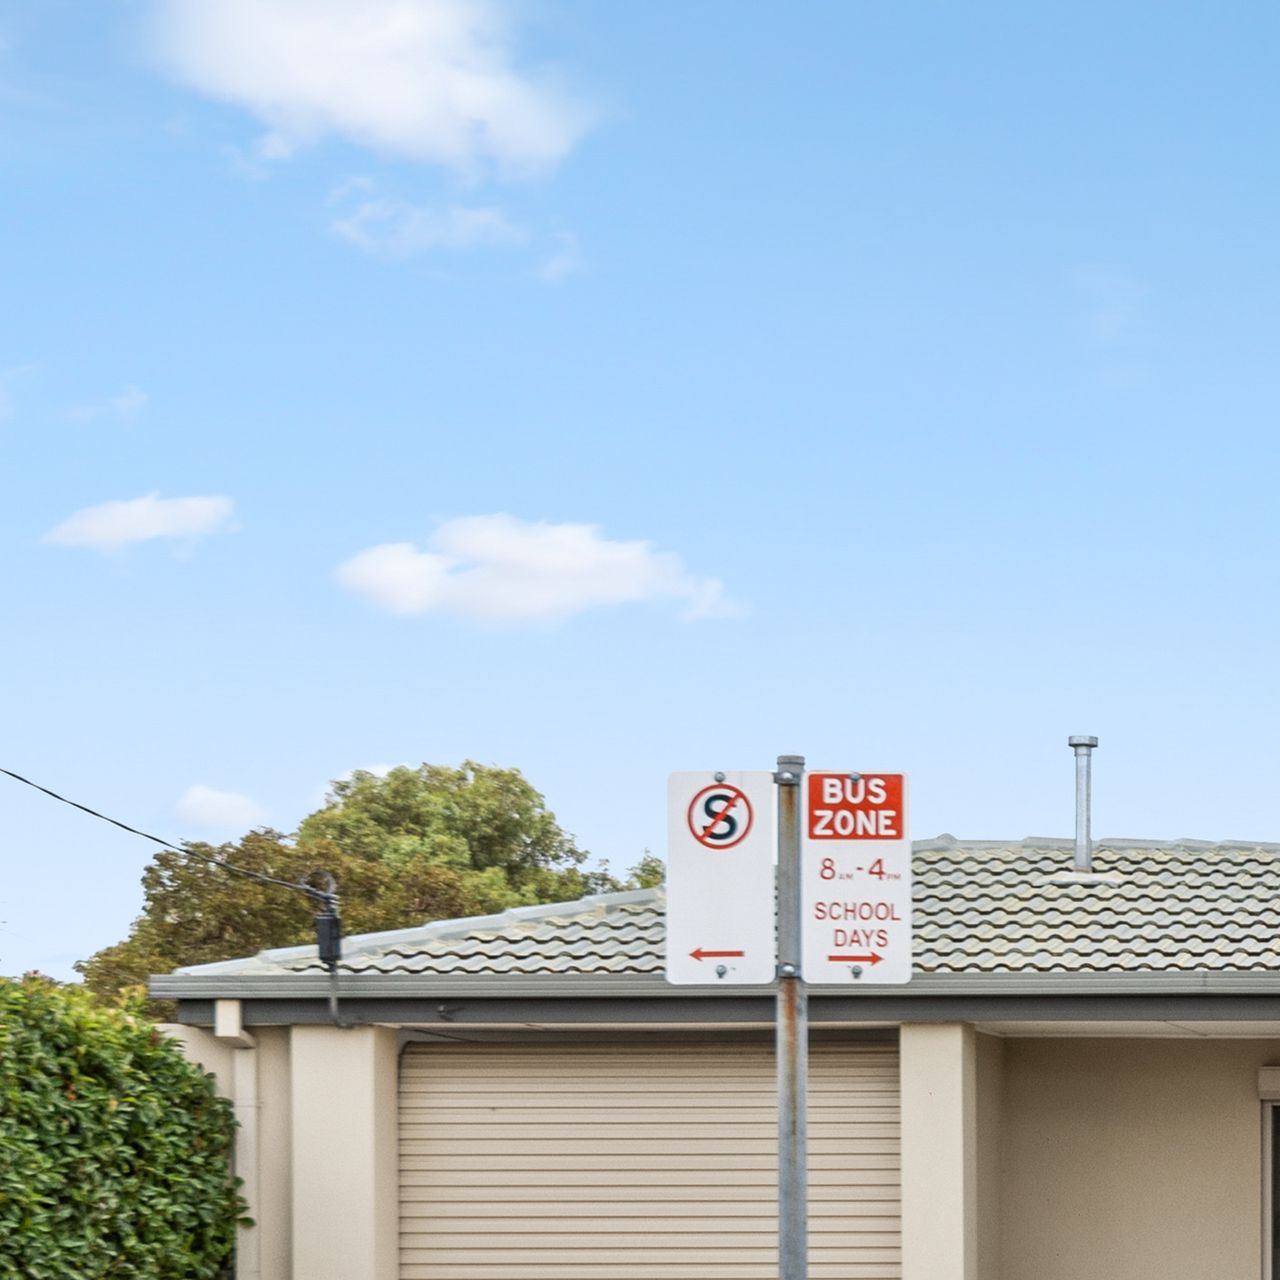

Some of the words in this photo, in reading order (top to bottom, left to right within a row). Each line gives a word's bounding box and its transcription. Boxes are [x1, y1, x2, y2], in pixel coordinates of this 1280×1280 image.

[822, 778, 887, 804] BUS
[813, 810, 897, 836] ZONE
[815, 902, 901, 921] SCHOOL
[834, 929, 888, 948] DAYS
